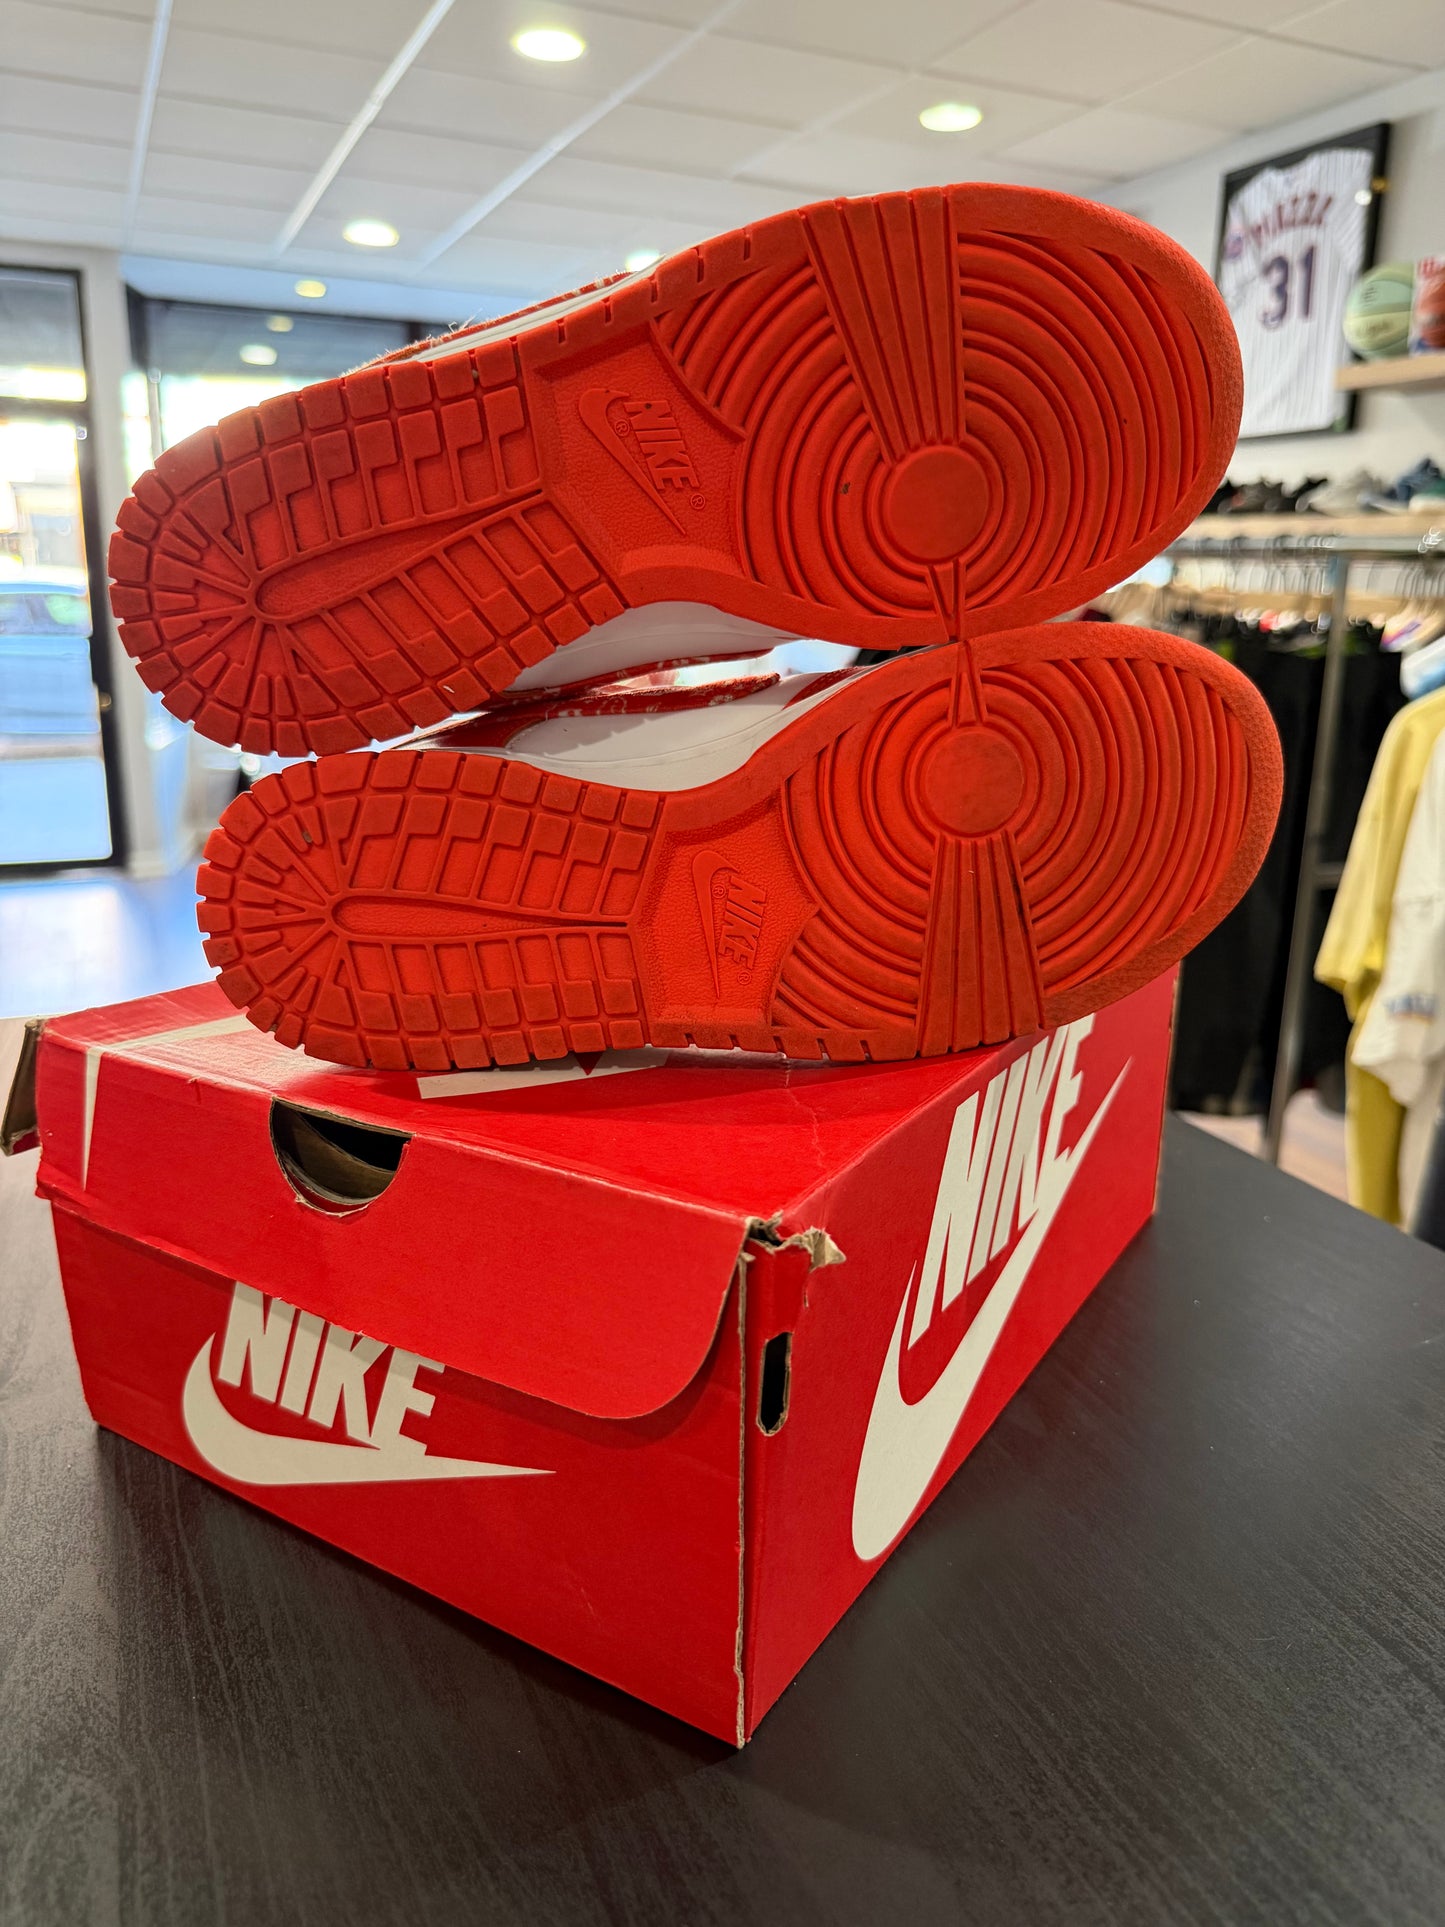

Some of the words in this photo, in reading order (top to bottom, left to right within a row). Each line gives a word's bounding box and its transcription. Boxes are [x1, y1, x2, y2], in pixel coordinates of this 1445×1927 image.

[1261, 244, 1316, 330] 31
[623, 400, 700, 490] NIKE
[717, 875, 766, 970] NIKE
[908, 1012, 1095, 1350] NIKE
[217, 1280, 446, 1456] NIKE
